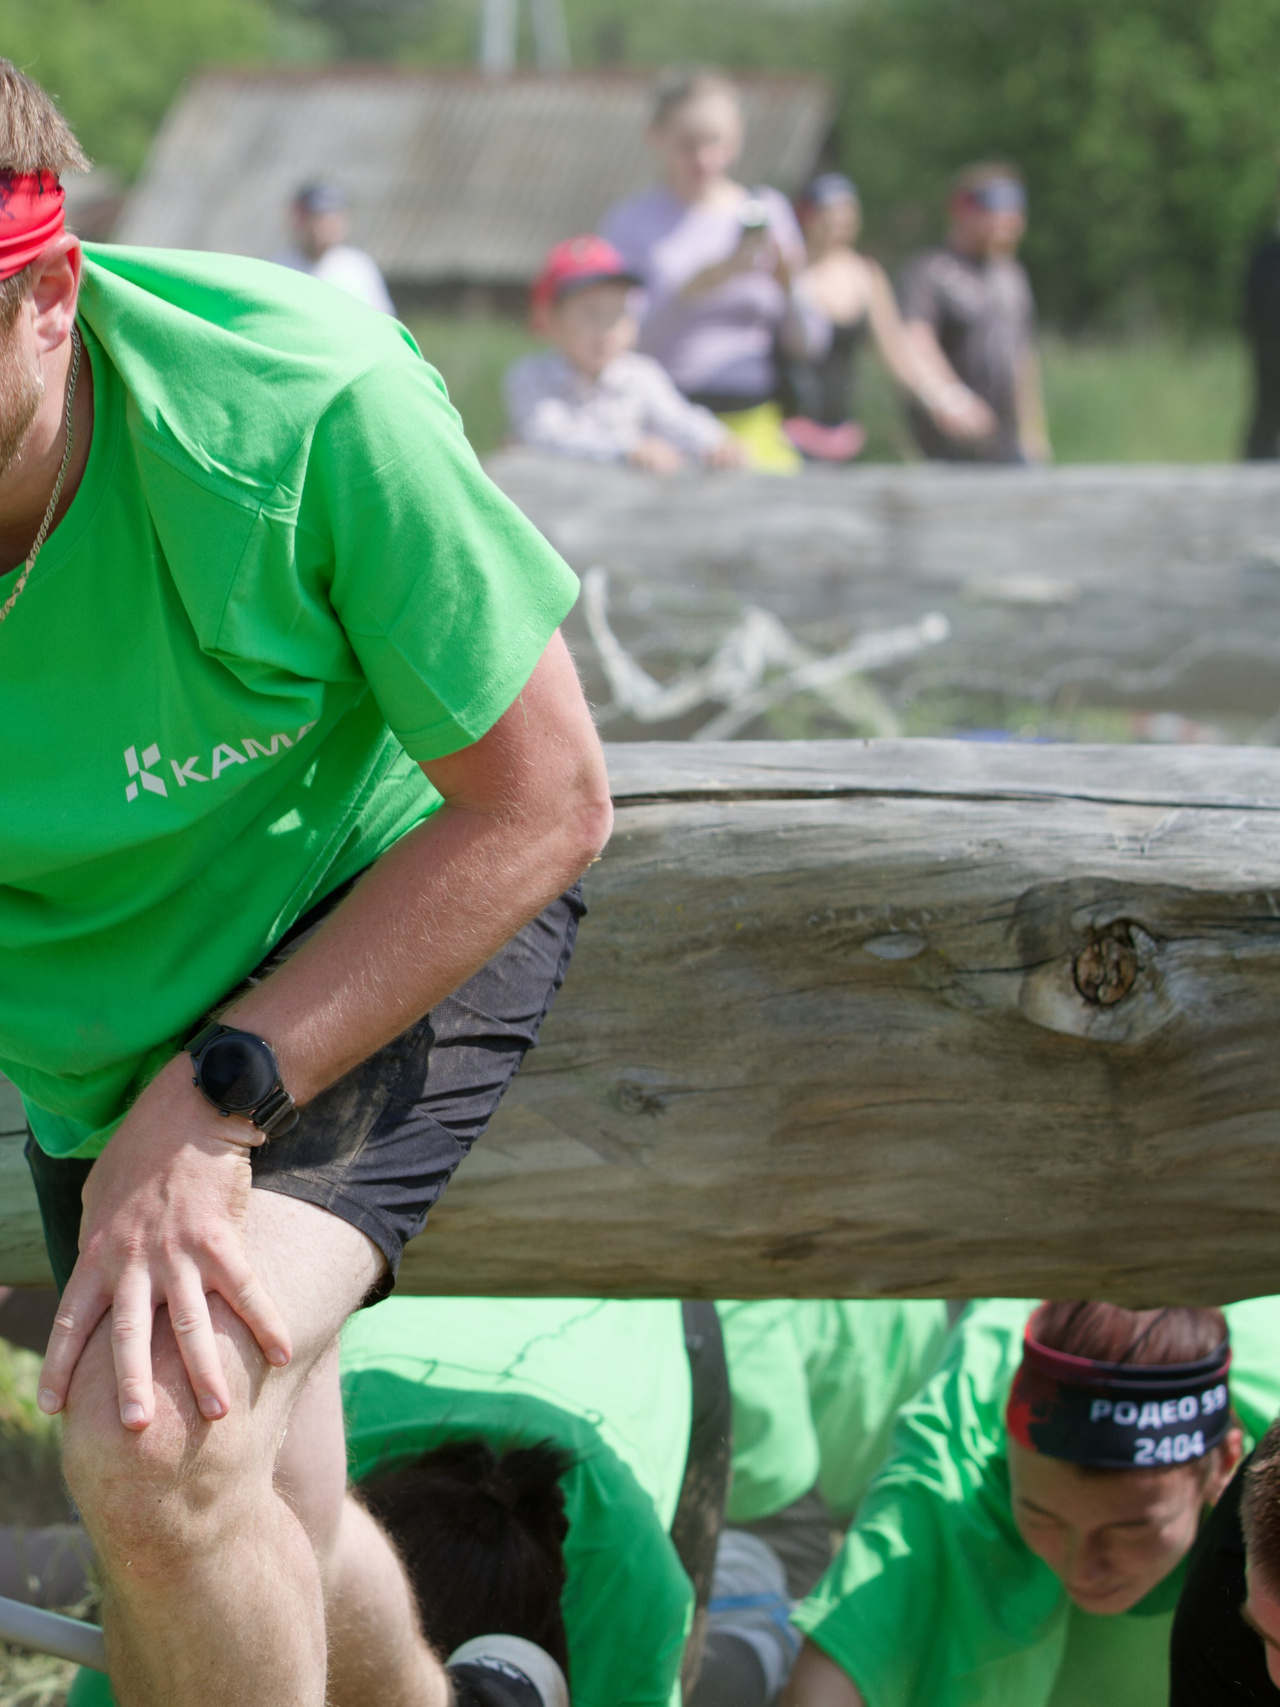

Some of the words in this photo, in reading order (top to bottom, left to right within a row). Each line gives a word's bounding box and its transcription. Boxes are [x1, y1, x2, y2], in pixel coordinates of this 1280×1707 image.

[1090, 1395, 1199, 1430] РОДЕО
[1201, 1384, 1228, 1416] 59
[1133, 1430, 1206, 1466] 2404
